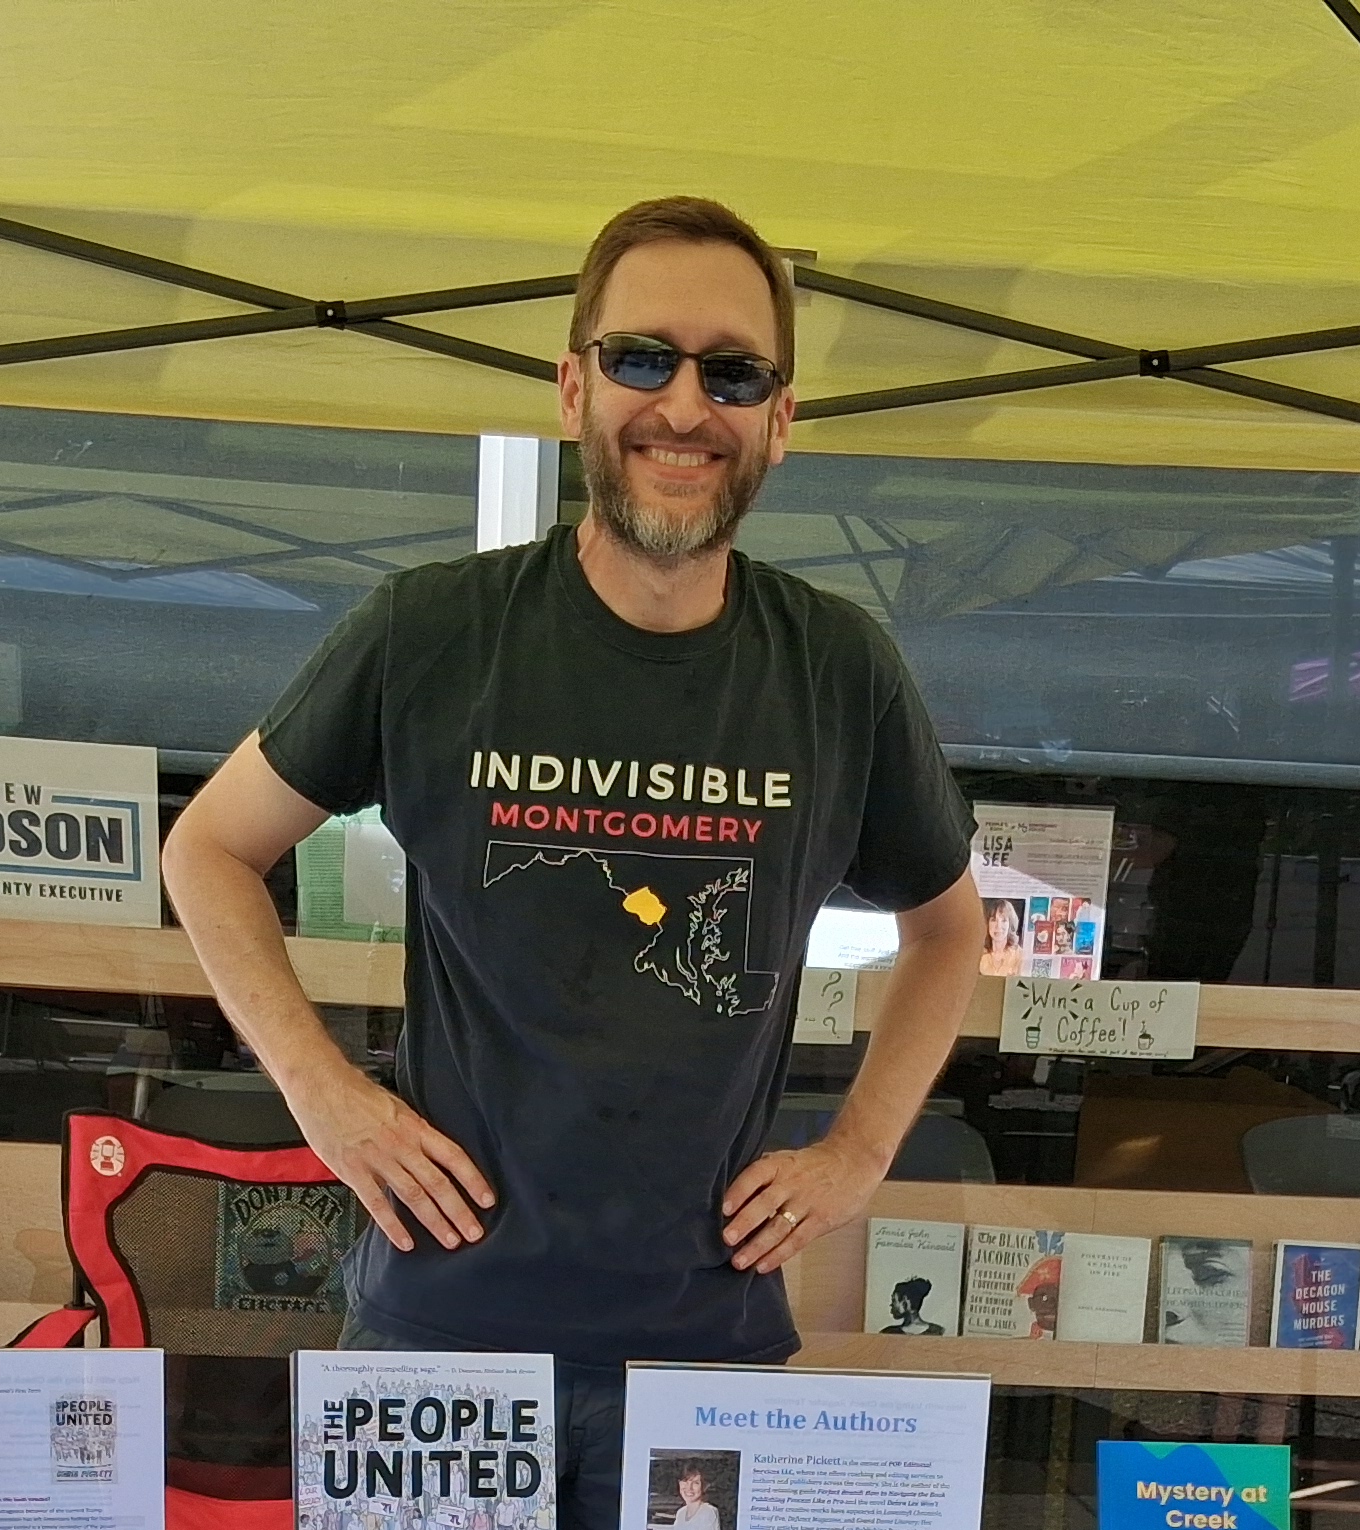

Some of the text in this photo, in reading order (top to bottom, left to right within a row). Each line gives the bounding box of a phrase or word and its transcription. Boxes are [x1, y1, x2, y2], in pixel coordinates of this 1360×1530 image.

[470, 751, 791, 807] INDIVISIBLE
[491, 802, 762, 842] MONTGOMERY
[984, 835, 1013, 852] LISA
[983, 852, 1010, 867] SEE
[39, 883, 123, 902] EXECUTIVE
[1031, 982, 1168, 1020] Win a Cup of
[1057, 1016, 1127, 1047] Coffee!
[978, 1232, 1036, 1250] The BLACK
[974, 1250, 1030, 1268] JACOBINS
[1310, 1270, 1332, 1283] THE
[1295, 1284, 1345, 1298] DECAGON
[1302, 1302, 1337, 1315] HOUSE
[1293, 1314, 1345, 1330] MURDERS
[332, 1365, 374, 1374] thoroughly
[60, 1399, 113, 1415] PEOPLE
[55, 1412, 113, 1427] UNITED
[324, 1400, 343, 1444] THE
[345, 1396, 538, 1443] PEOPLE
[695, 1405, 918, 1434] Meet the Authors
[753, 1453, 840, 1466] Katherine Pickett
[323, 1450, 541, 1499] UNITED
[1136, 1480, 1267, 1507] Mystery at
[1165, 1510, 1238, 1530] Creek
